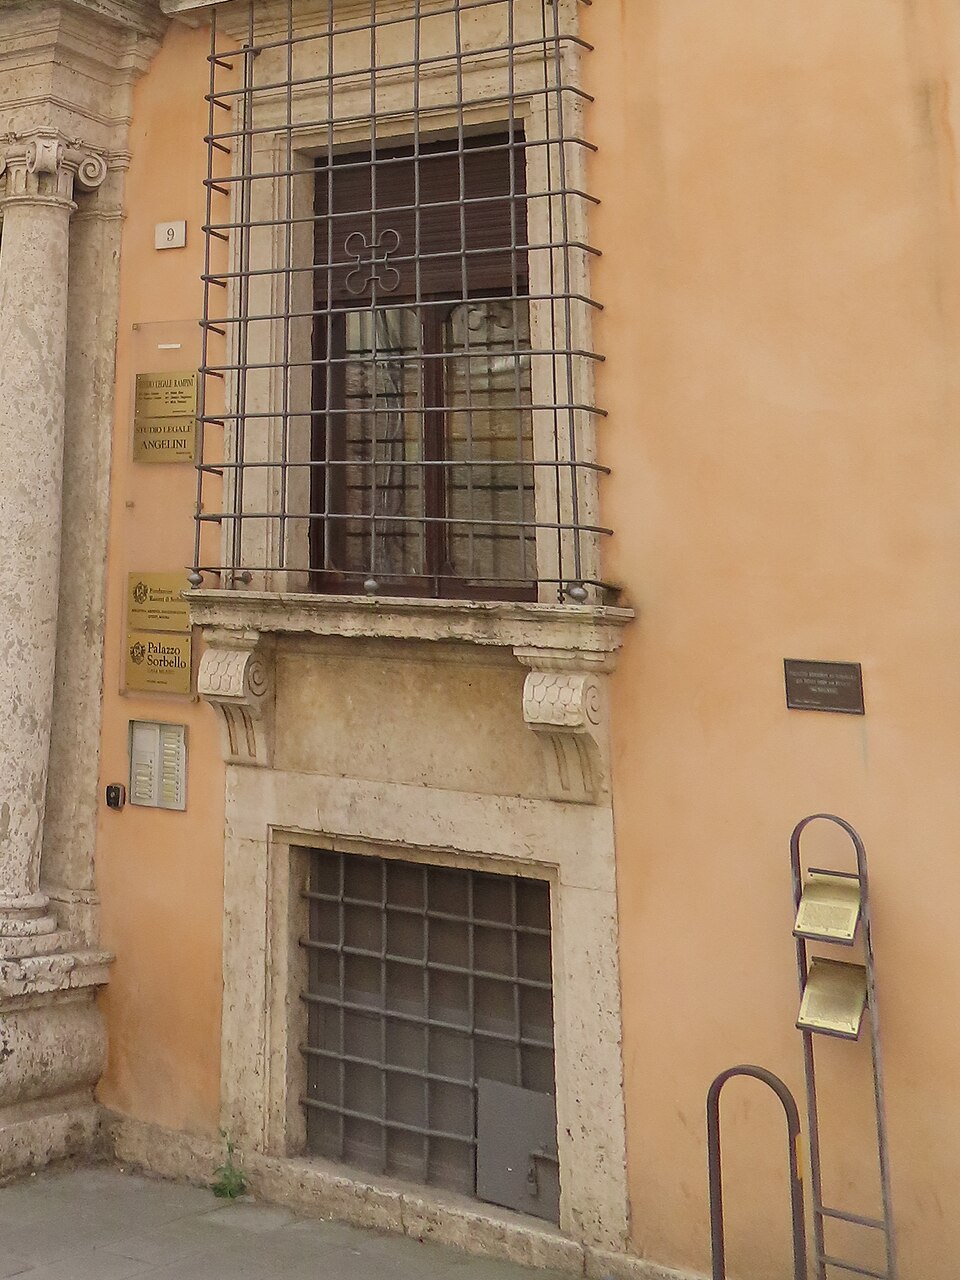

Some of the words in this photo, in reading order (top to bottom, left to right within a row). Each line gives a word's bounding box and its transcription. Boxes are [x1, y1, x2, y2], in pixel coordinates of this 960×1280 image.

[166, 227, 175, 242] 9
[136, 426, 162, 434] STUDIO
[163, 425, 192, 433] LEGALE
[142, 439, 187, 449] ANGELINI
[148, 641, 181, 655] Palazzo
[147, 655, 187, 669] Sorbello
